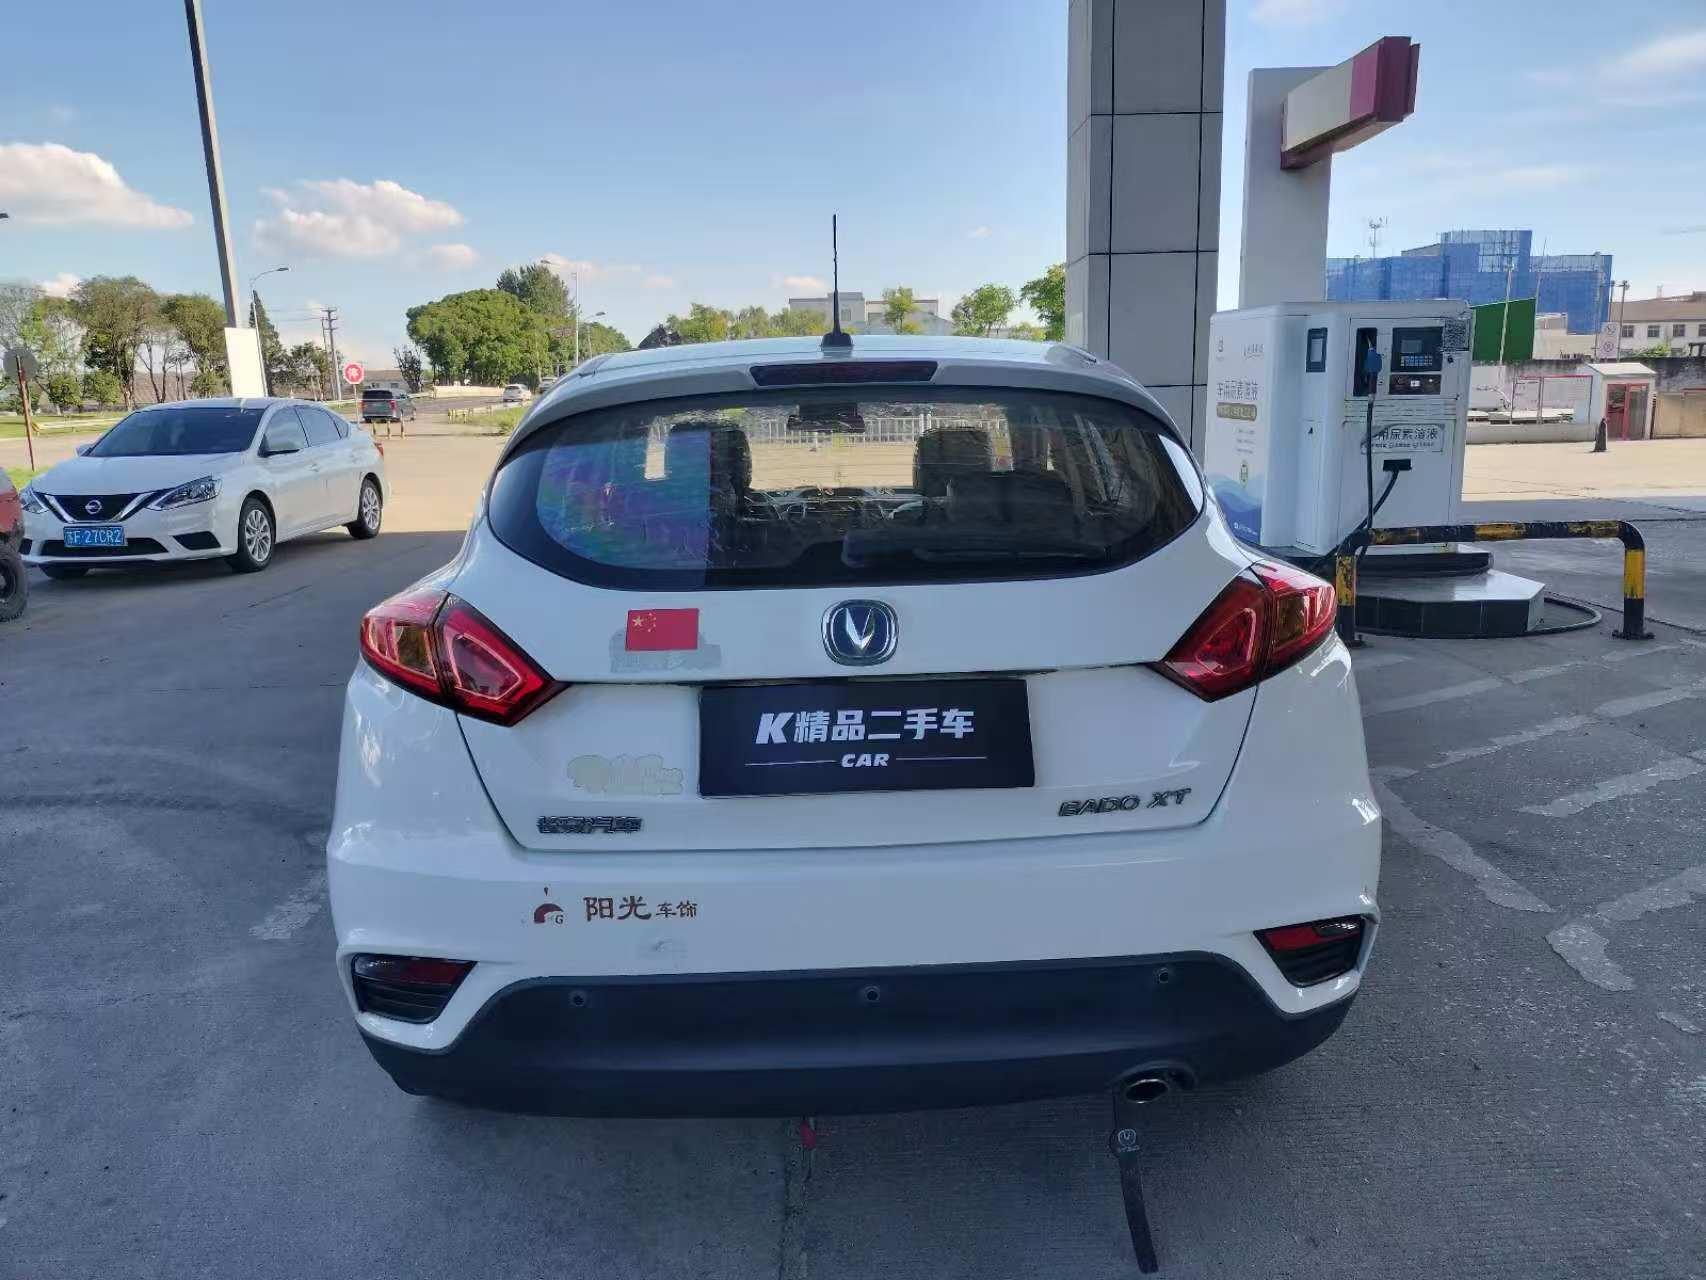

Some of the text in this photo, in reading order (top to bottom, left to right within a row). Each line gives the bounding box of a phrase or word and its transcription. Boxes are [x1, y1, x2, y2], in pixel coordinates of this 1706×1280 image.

[841, 753, 890, 768] CAR
[1058, 787, 1192, 817] EADO XT
